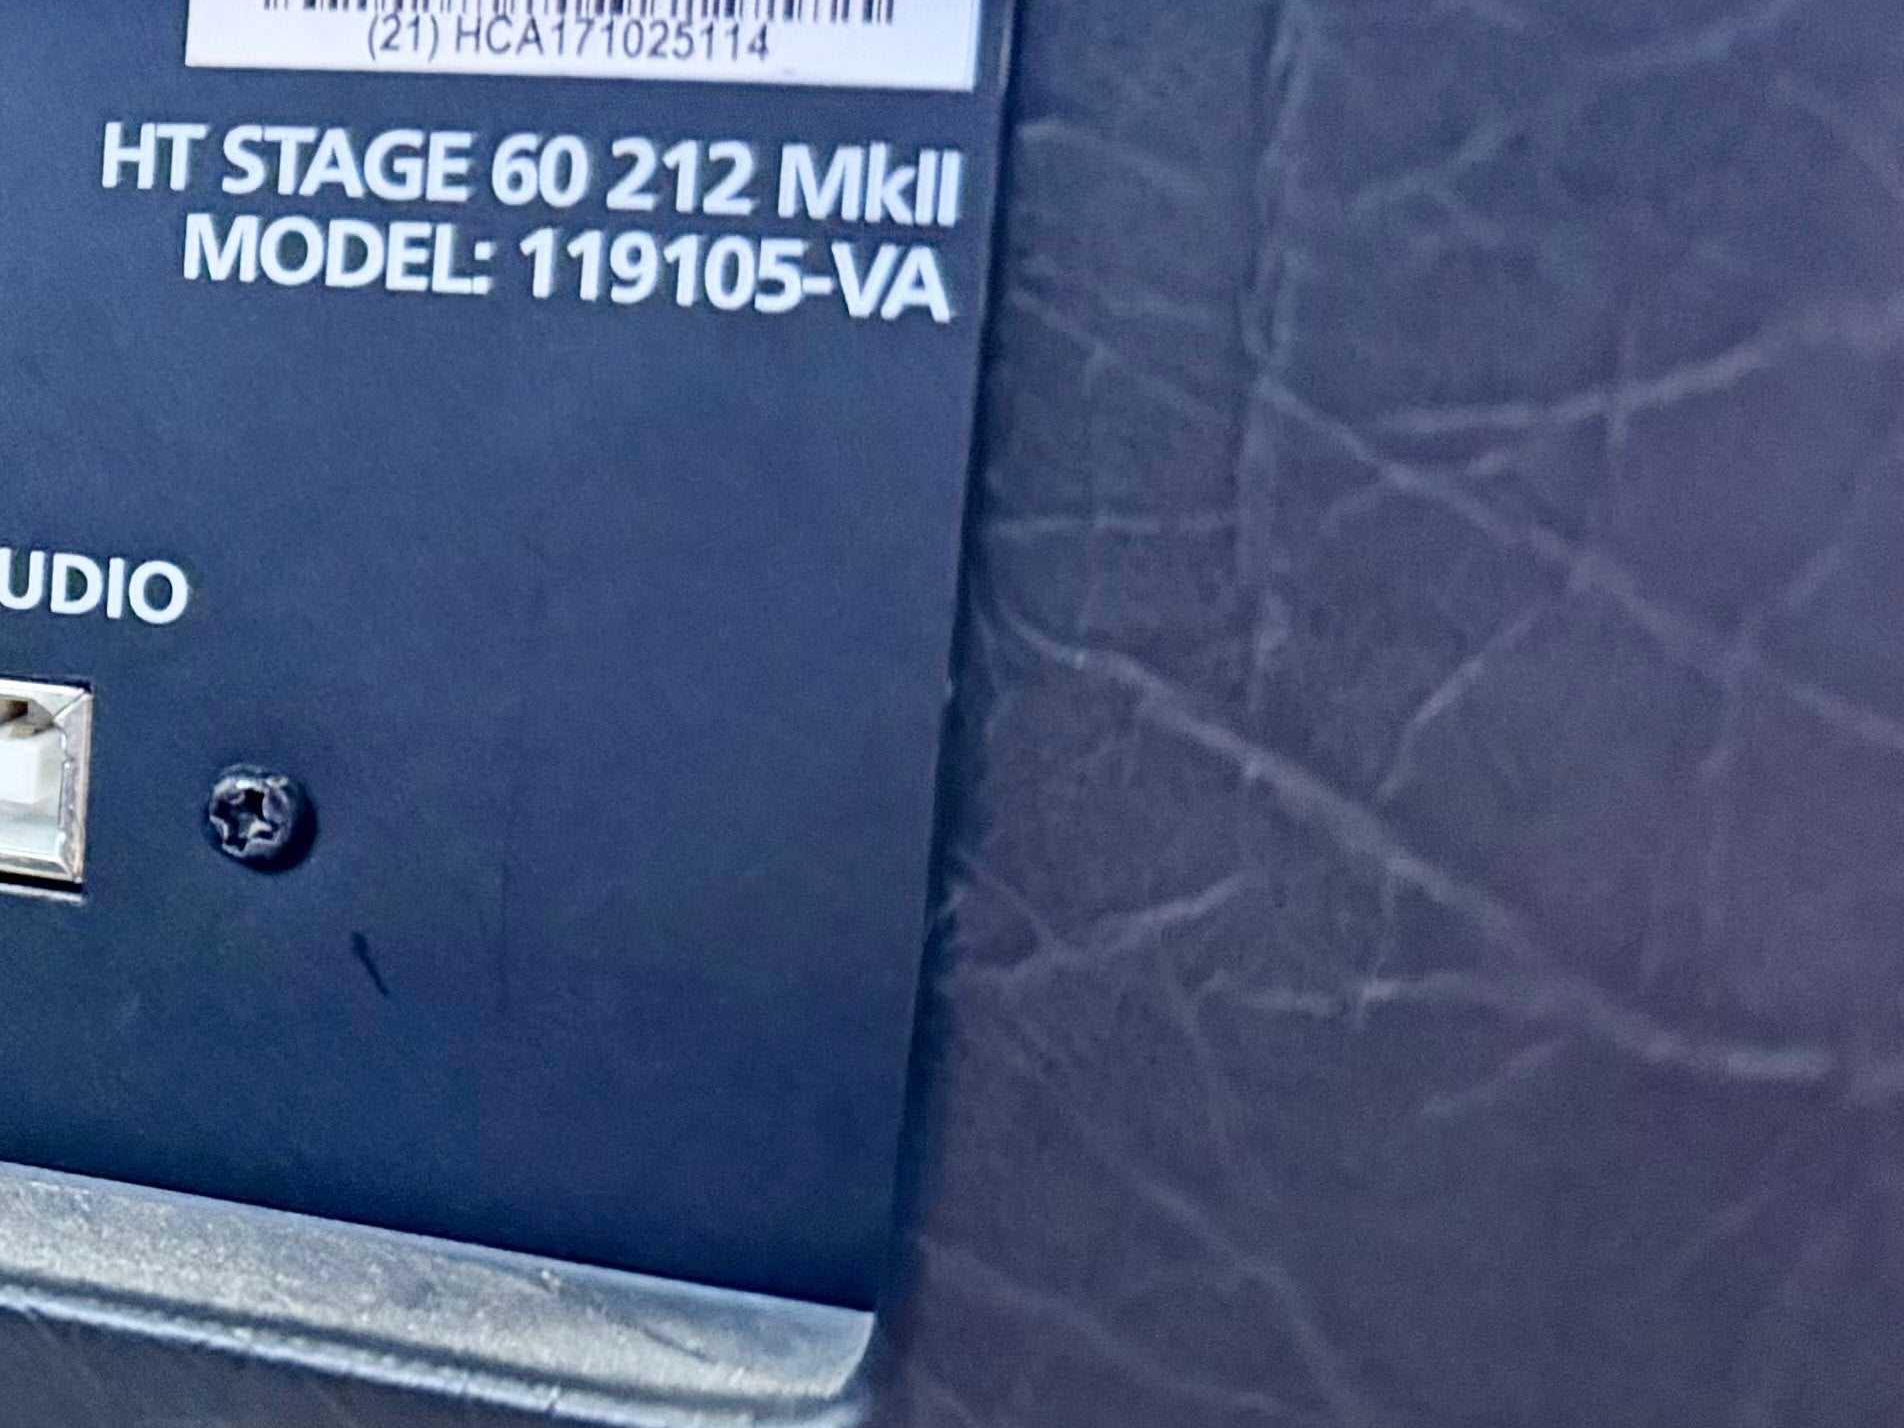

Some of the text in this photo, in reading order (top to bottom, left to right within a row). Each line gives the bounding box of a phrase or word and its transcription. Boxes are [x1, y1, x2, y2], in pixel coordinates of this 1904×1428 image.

[367, 13, 770, 62] (21) HCA171025114
[101, 121, 963, 229] HT STAGE 60 212 MkII
[182, 213, 954, 324] MODEL: 119105-VA
